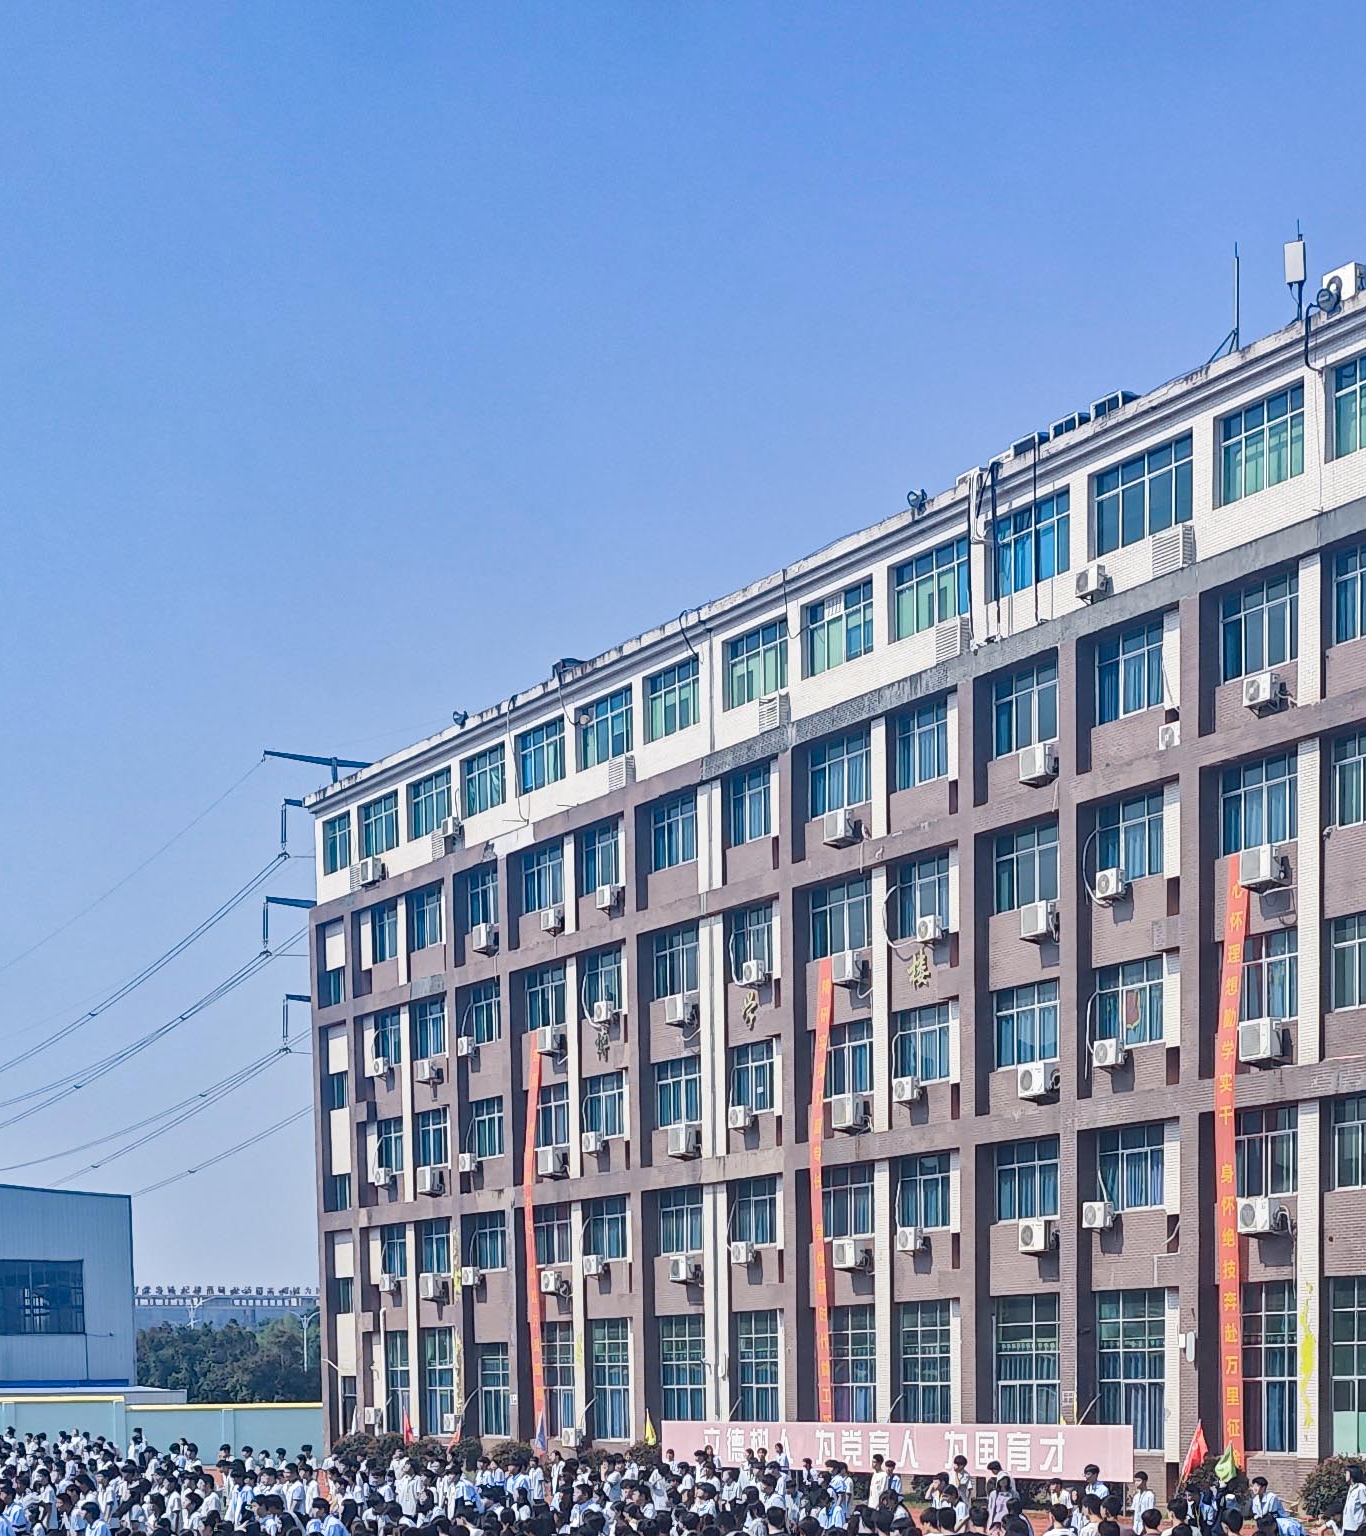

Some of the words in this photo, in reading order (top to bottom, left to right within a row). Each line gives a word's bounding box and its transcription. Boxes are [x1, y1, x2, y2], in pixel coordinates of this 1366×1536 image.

[703, 1427, 793, 1465] 立德树人
[815, 1429, 919, 1469] 为党育人
[944, 1430, 1066, 1473] 为国育才
